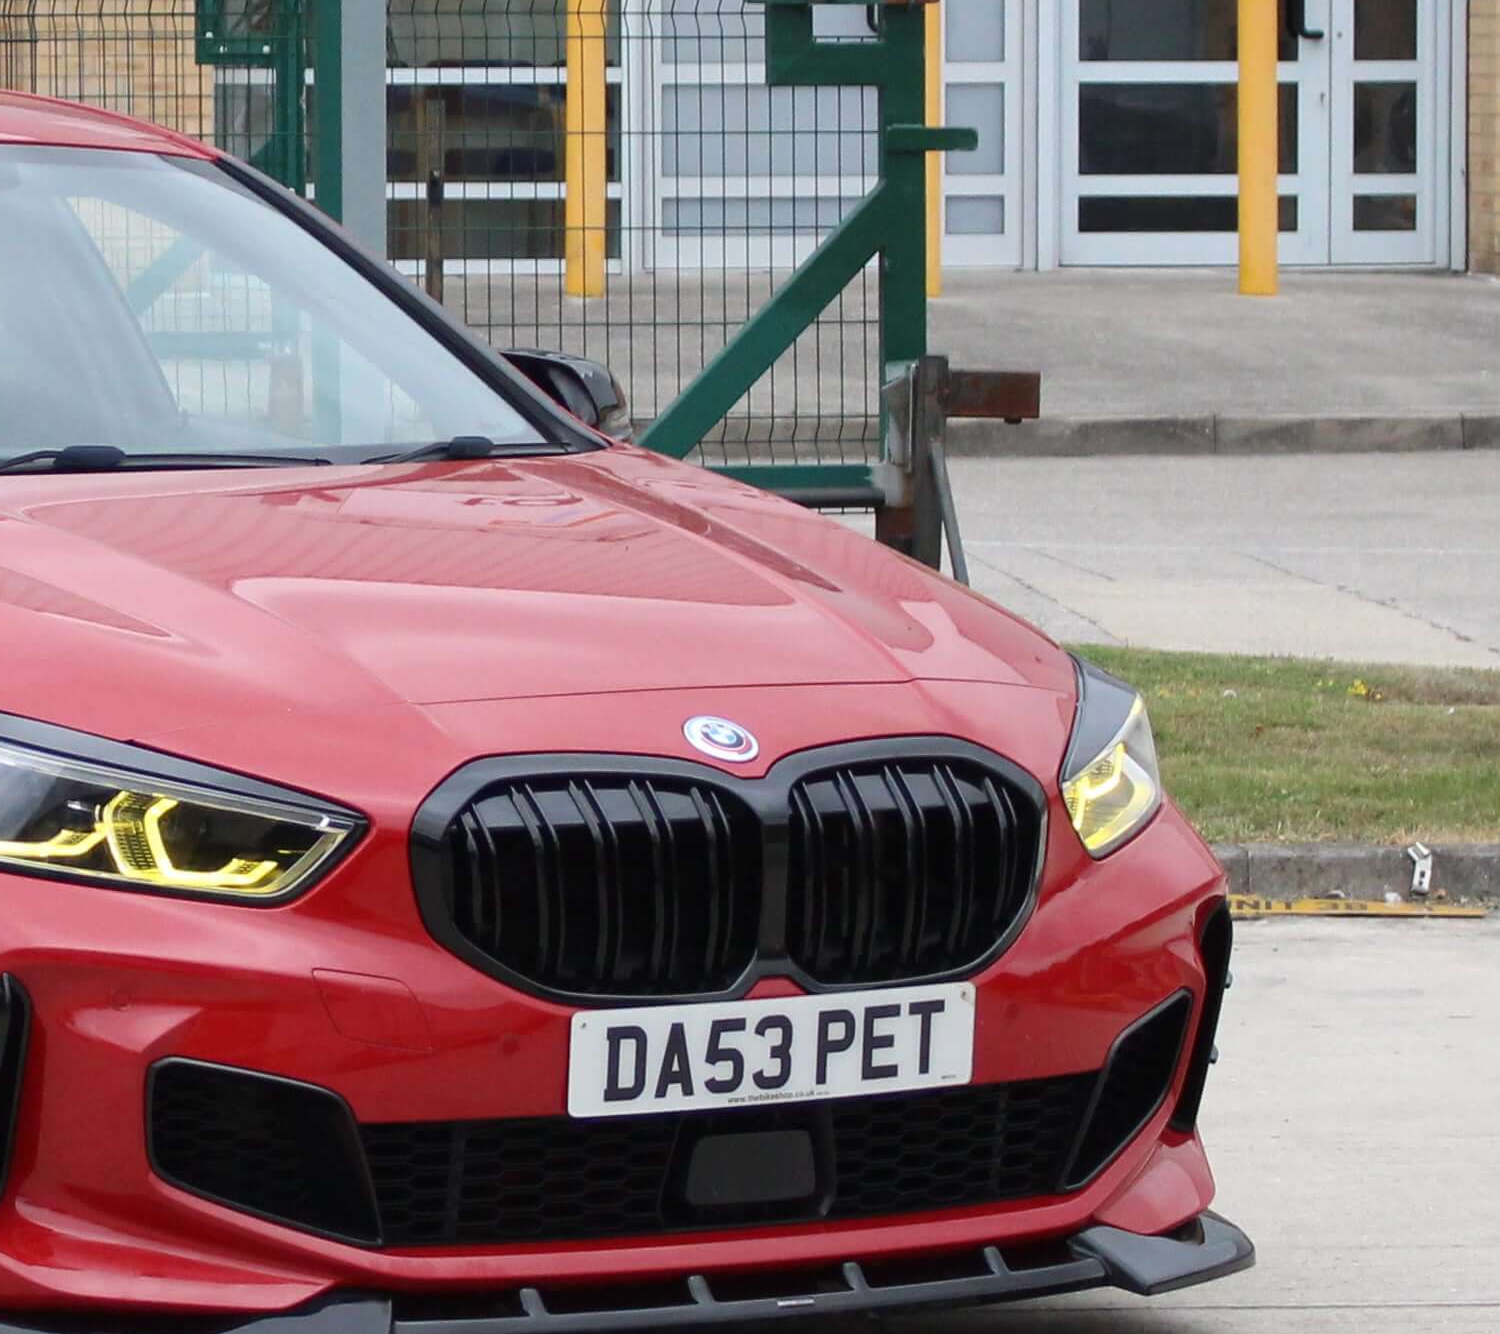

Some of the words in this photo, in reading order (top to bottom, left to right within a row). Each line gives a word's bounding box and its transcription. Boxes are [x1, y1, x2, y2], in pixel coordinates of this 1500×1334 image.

[1230, 898, 1293, 910] NIT
[603, 1015, 793, 1102] DA53
[816, 999, 945, 1085] PET
